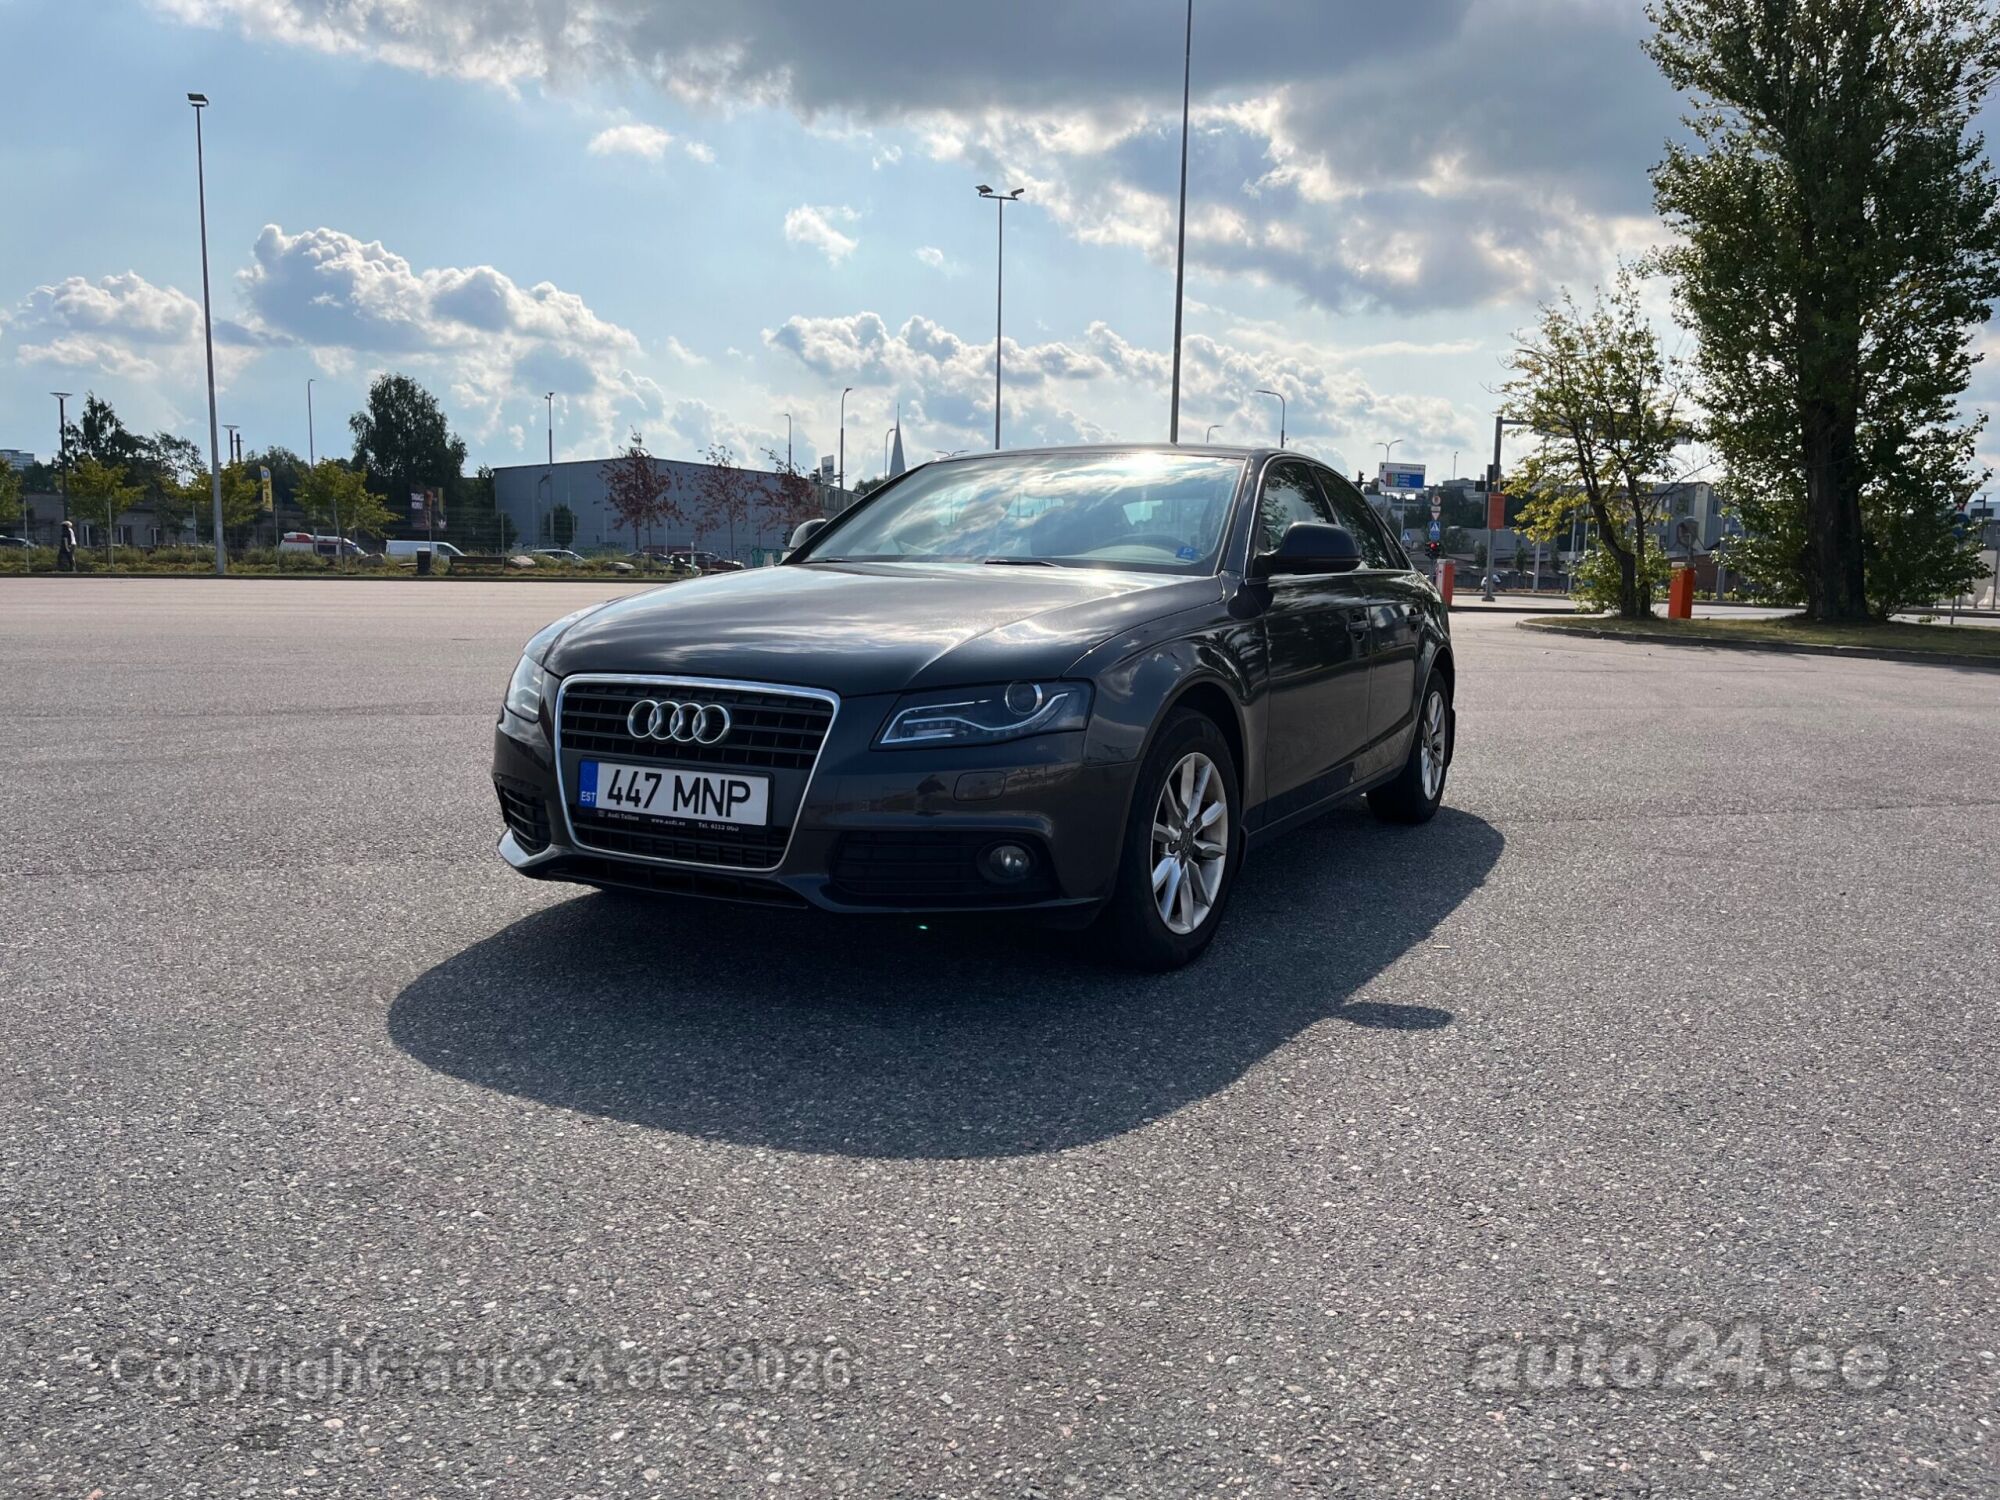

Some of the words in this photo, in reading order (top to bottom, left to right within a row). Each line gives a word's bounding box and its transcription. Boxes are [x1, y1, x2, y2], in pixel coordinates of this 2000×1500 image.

[581, 791, 596, 803] EST
[607, 769, 662, 809] 447
[673, 775, 751, 818] MNP
